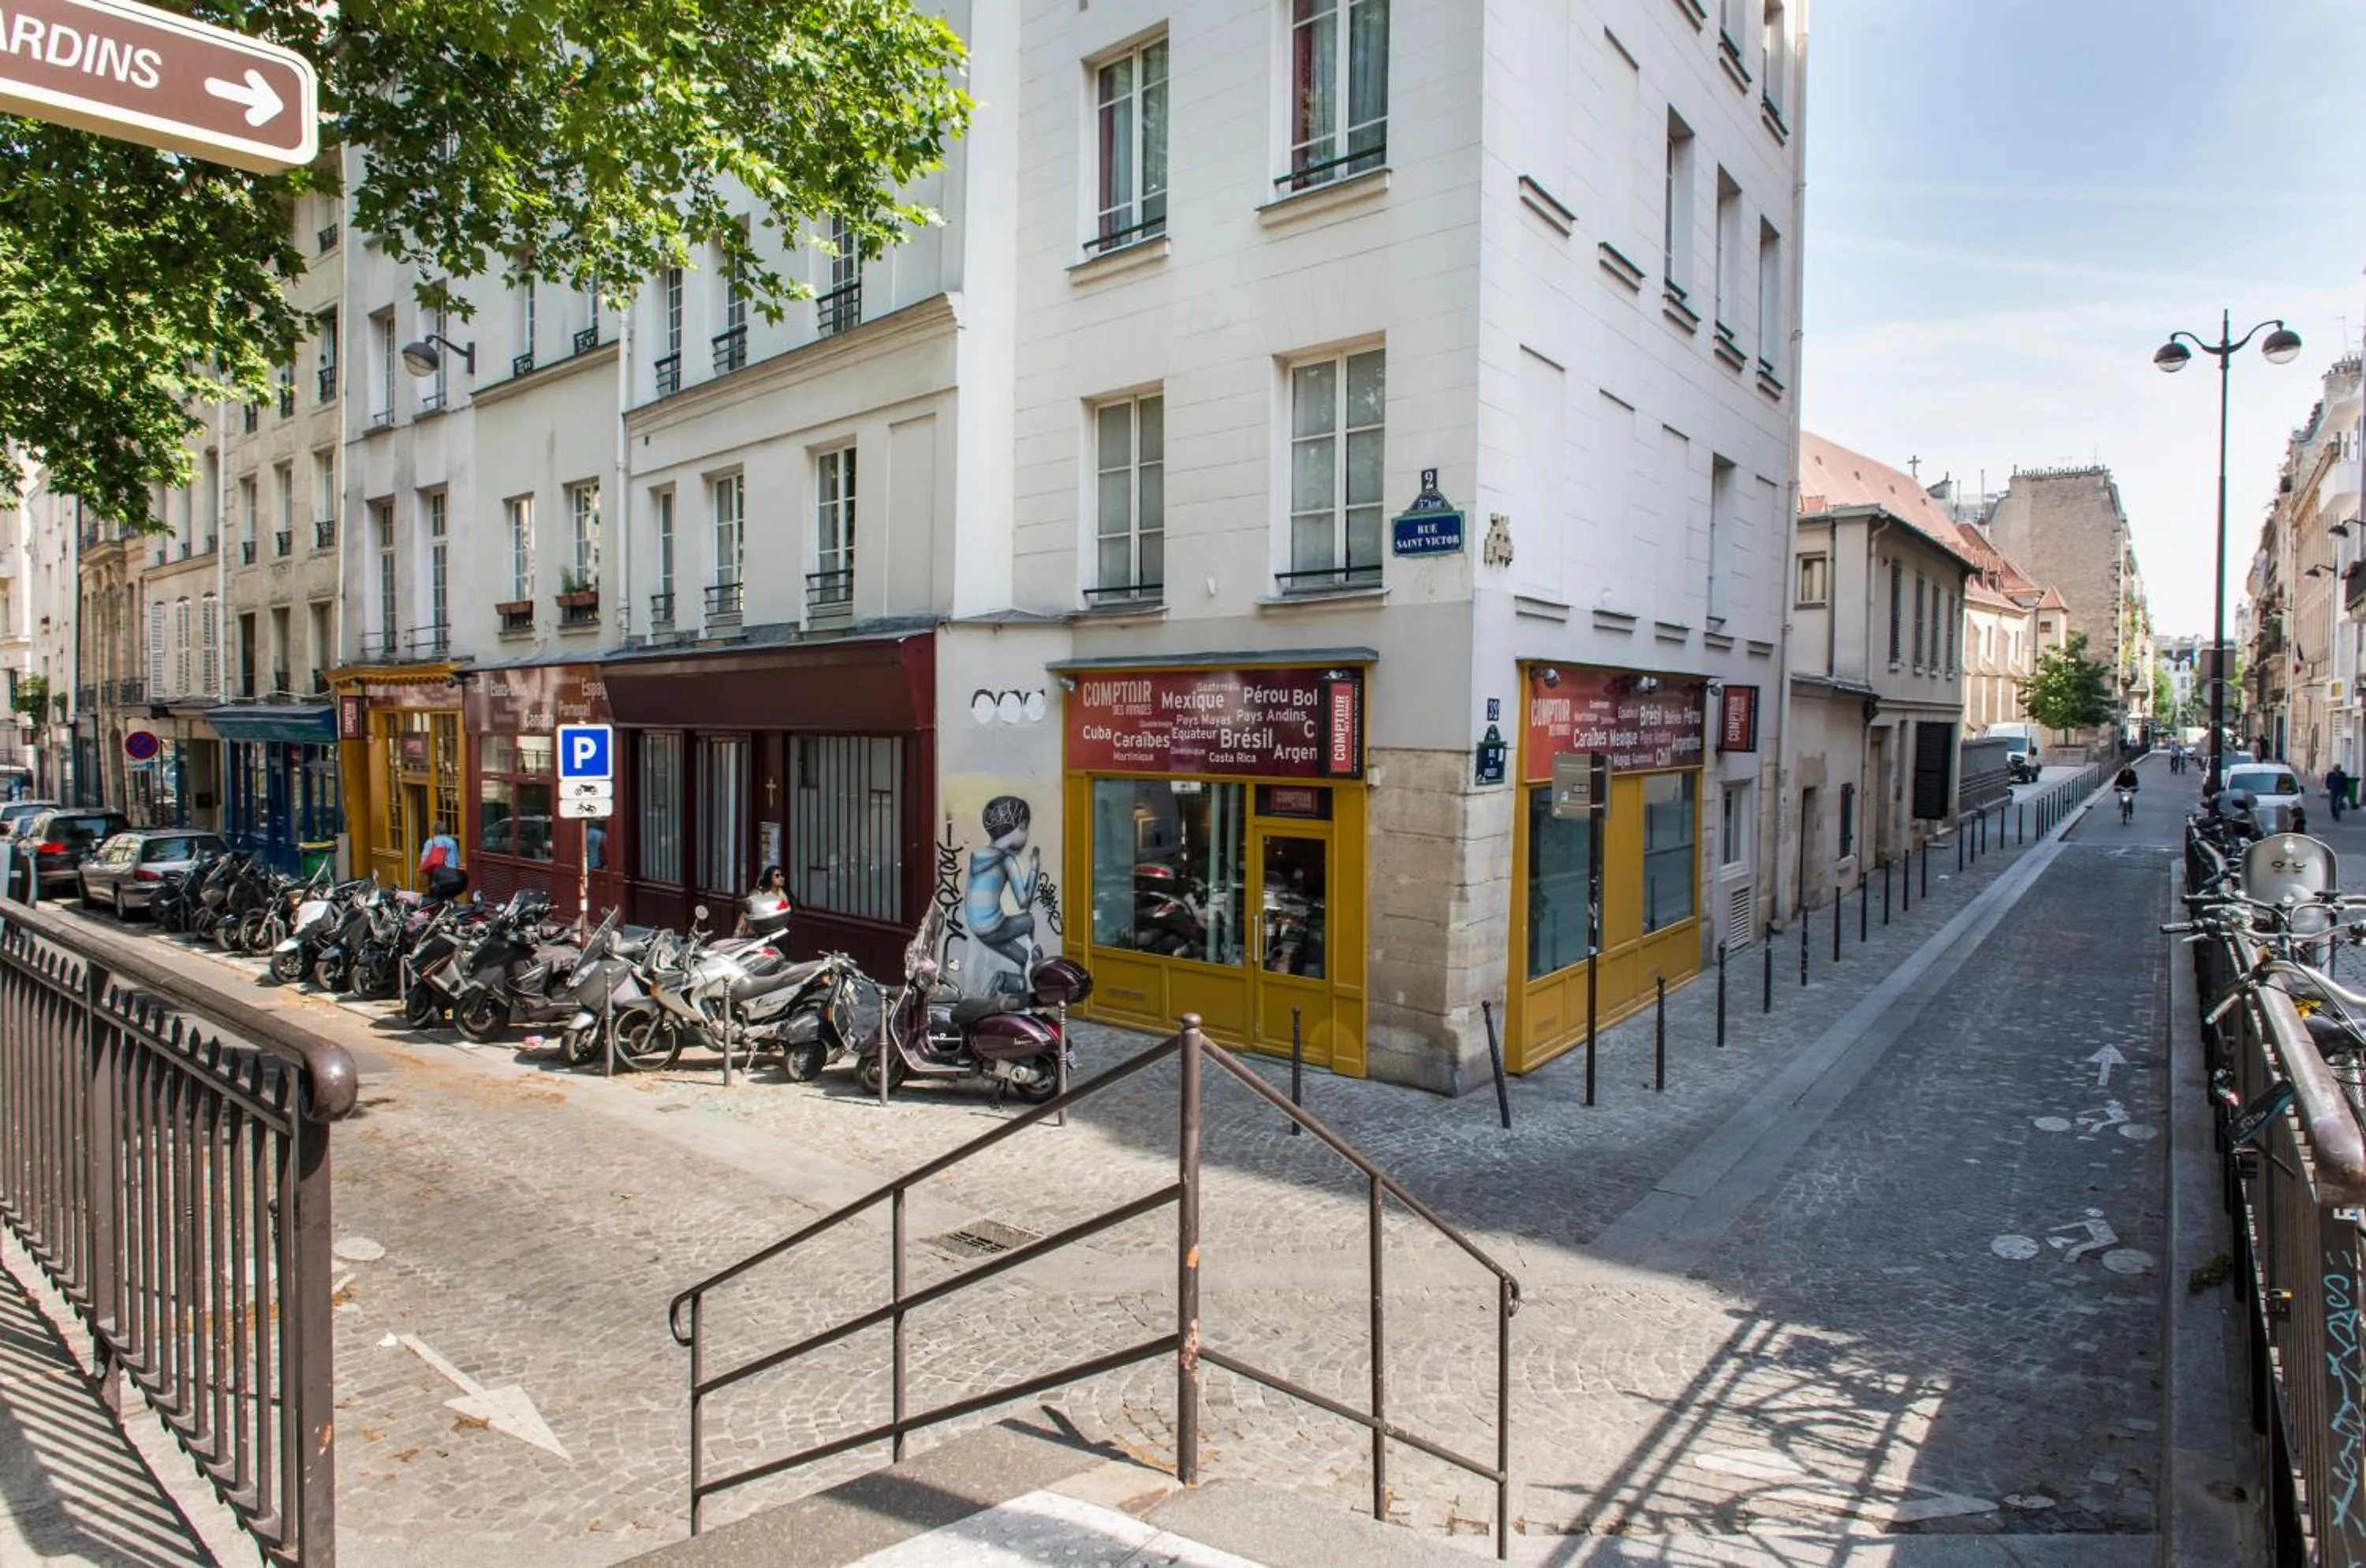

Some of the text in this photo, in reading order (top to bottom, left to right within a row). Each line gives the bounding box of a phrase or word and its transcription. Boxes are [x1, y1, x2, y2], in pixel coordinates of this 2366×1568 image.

[1424, 471, 1434, 489] 2
[1417, 523, 1438, 534] RUE
[1397, 535, 1459, 550] SAINT VICTOR
[1083, 681, 1152, 707] COMPTOIR
[1162, 690, 1225, 711] Mexique
[1244, 685, 1289, 704] Pérou
[1176, 714, 1200, 726] Pays
[1201, 714, 1232, 726] Mayas
[1236, 708, 1308, 723] Pays Andins
[1640, 704, 1663, 726] Brésil
[1083, 725, 1111, 740] Cuba
[1172, 726, 1217, 741] Equateur
[1334, 694, 1346, 762] COMPTOIR
[1573, 726, 1607, 748] Caraïbes
[1113, 731, 1170, 748] Caraïbes
[1220, 726, 1273, 749] Brésil
[573, 736, 597, 769] P
[1209, 752, 1256, 763] Costa Rica
[1274, 744, 1318, 763] Argen
